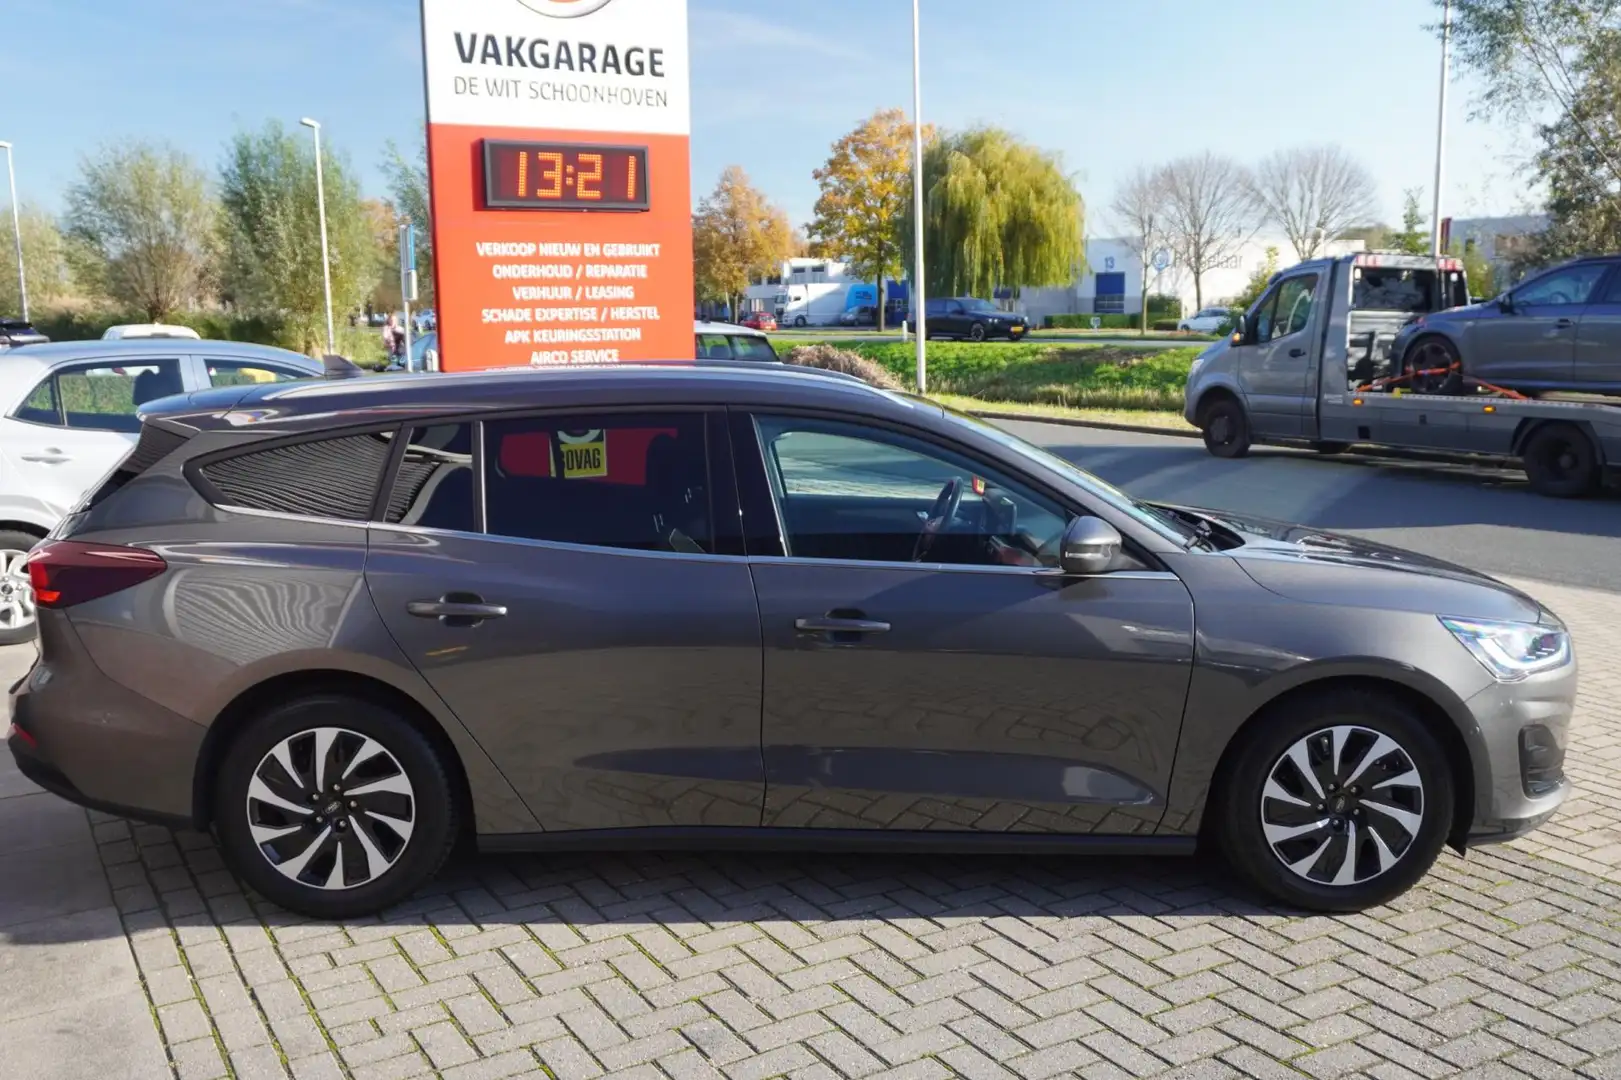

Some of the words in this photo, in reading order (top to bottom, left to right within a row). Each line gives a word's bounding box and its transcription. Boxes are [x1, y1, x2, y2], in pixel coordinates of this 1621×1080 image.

[453, 31, 665, 78] VAKGARAGE
[453, 76, 479, 96] DE
[484, 78, 522, 99] WIT
[528, 81, 668, 108] SCHOONHOVEN
[517, 150, 637, 200] 13:21
[476, 242, 537, 257] VERKOOP
[539, 243, 581, 257] NIEUW
[584, 243, 600, 256] EN
[603, 243, 661, 257] GEBRUIKT
[492, 264, 573, 279] ONDERHOUD
[586, 264, 648, 279] REPARATIE
[512, 286, 572, 300] VERHUUR
[585, 286, 635, 300] LEASING
[481, 308, 532, 323] SCHADE
[535, 307, 597, 322] EXPERTISE
[610, 306, 660, 321] HERSTEL
[504, 329, 530, 344] APK
[533, 328, 641, 344] KEURINGSSTATION
[530, 350, 568, 365] AIRCO
[571, 349, 620, 364] SERVICE
[562, 447, 602, 471] OVAG
